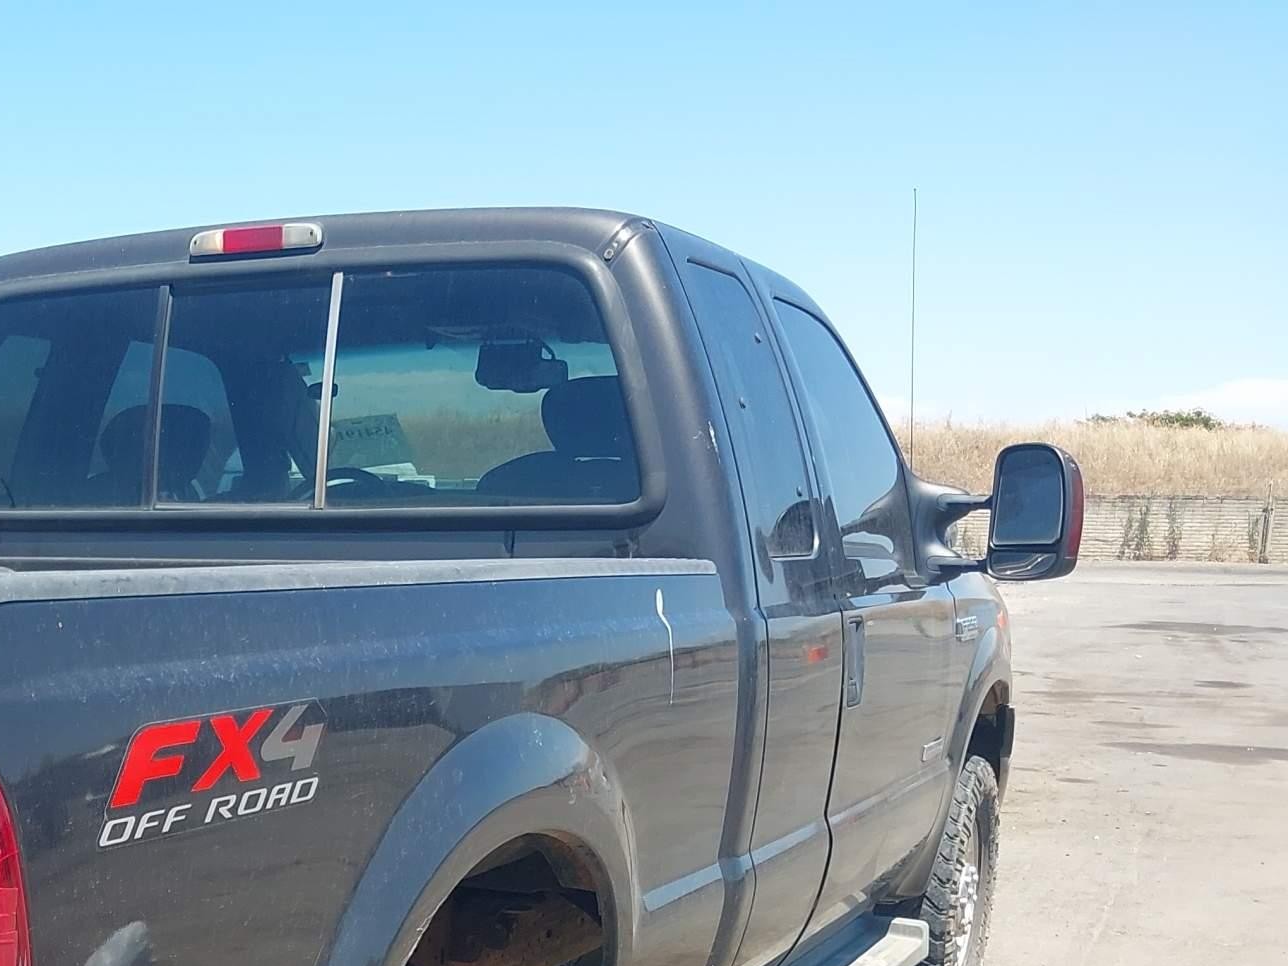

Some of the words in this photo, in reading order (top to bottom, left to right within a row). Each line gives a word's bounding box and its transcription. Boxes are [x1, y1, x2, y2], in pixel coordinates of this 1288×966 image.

[111, 704, 324, 809] FX4
[99, 803, 192, 847] OFF
[204, 777, 319, 824] ROAD
